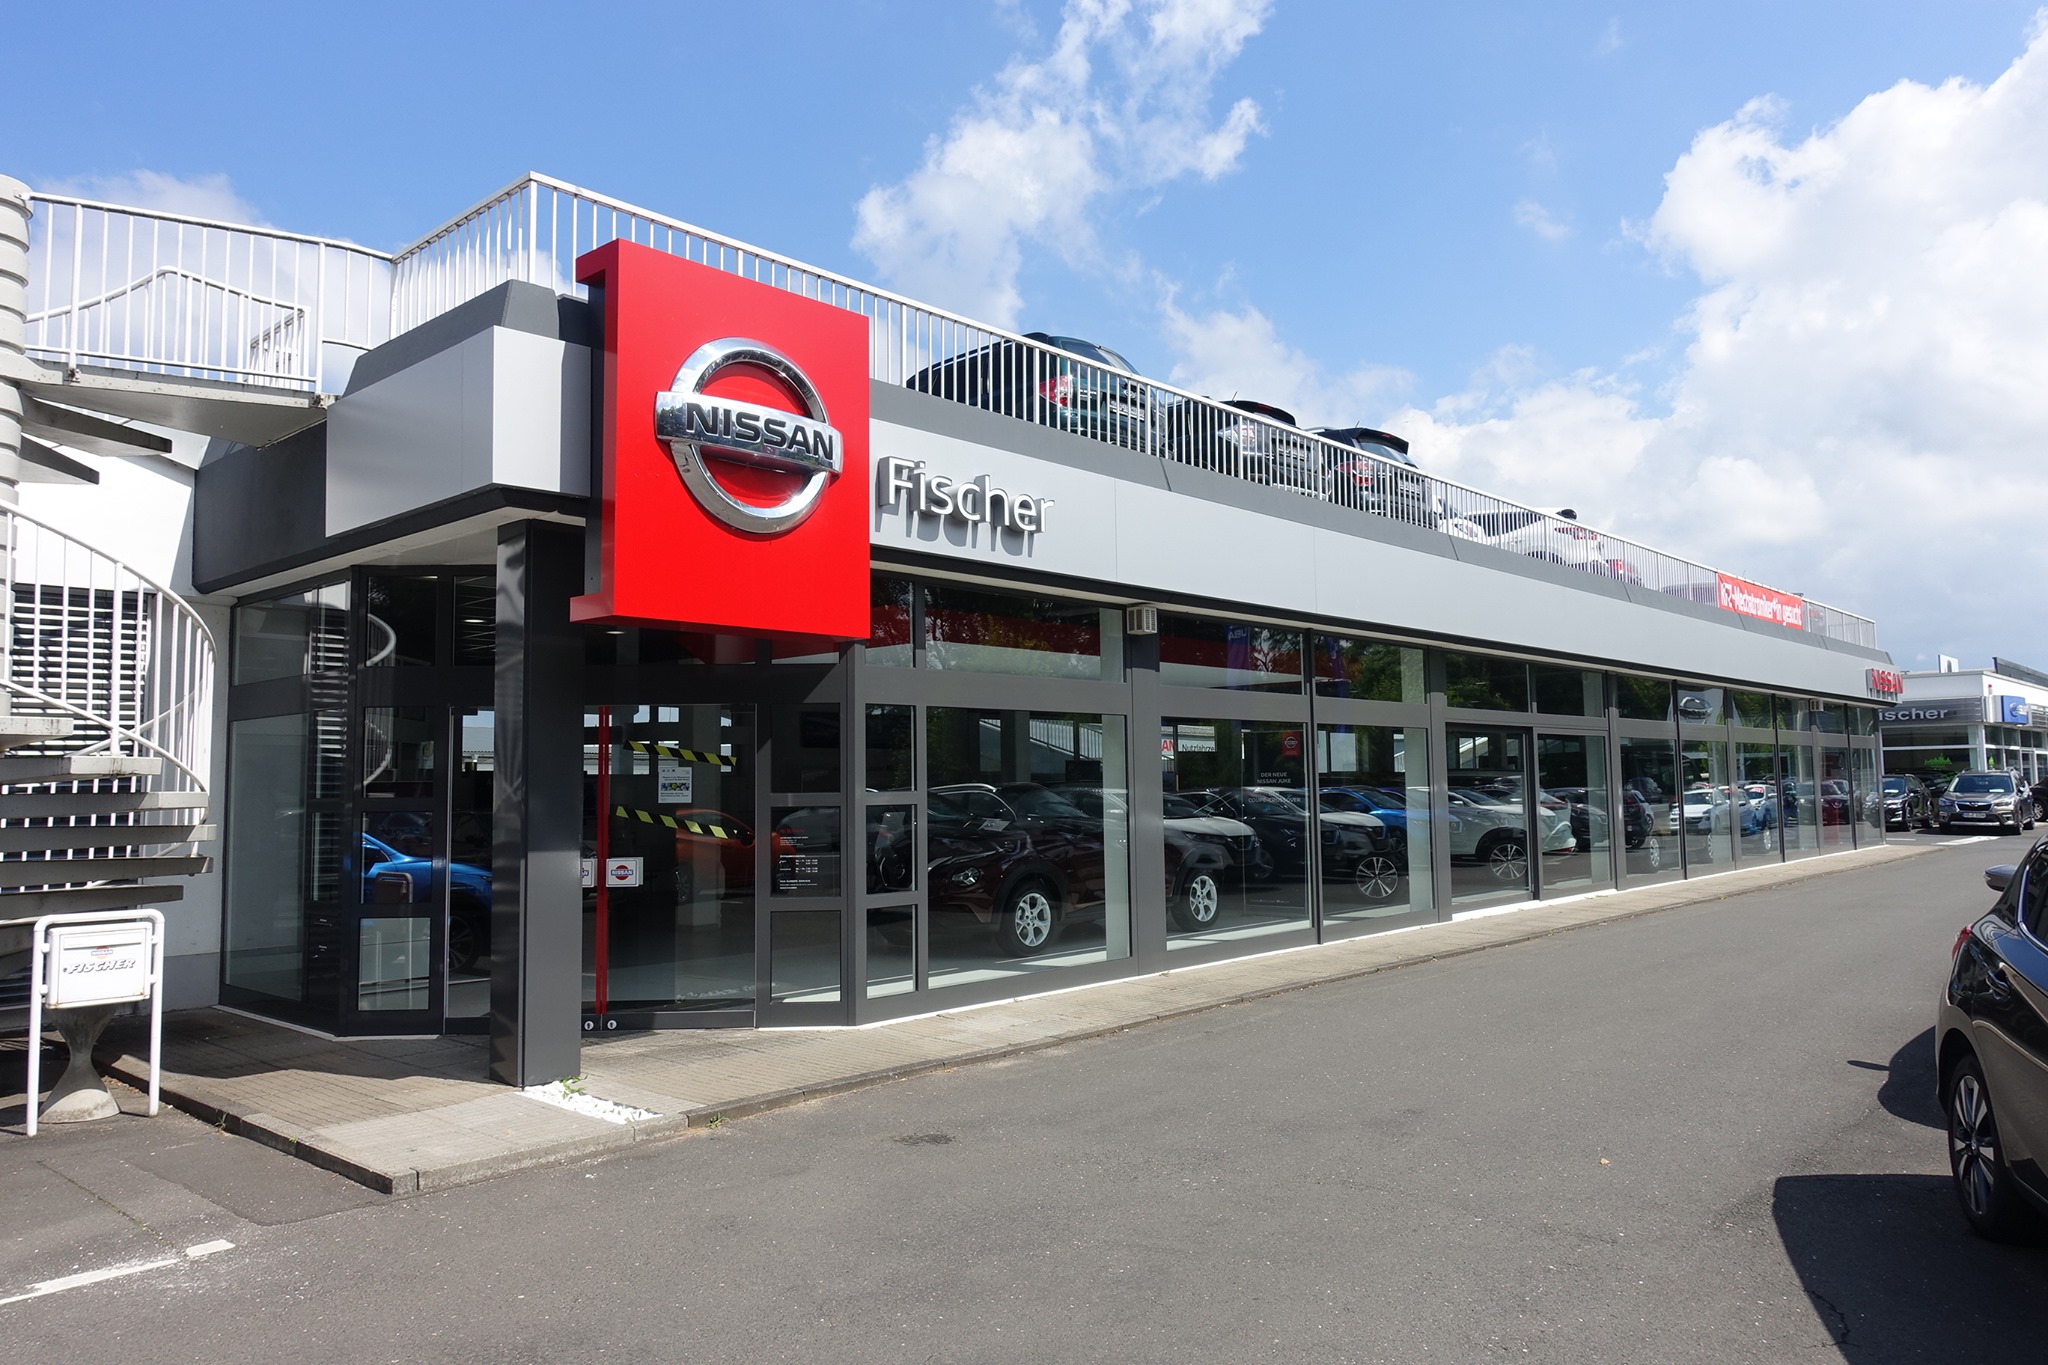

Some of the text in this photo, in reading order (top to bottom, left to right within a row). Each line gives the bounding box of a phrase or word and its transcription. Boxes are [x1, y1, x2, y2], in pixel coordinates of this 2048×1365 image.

[685, 402, 834, 461] NISSAN
[879, 456, 1055, 533] Fischer
[1869, 668, 1904, 694] NISSAN
[1878, 708, 1948, 721] ischer
[68, 959, 136, 975] FISCHER
